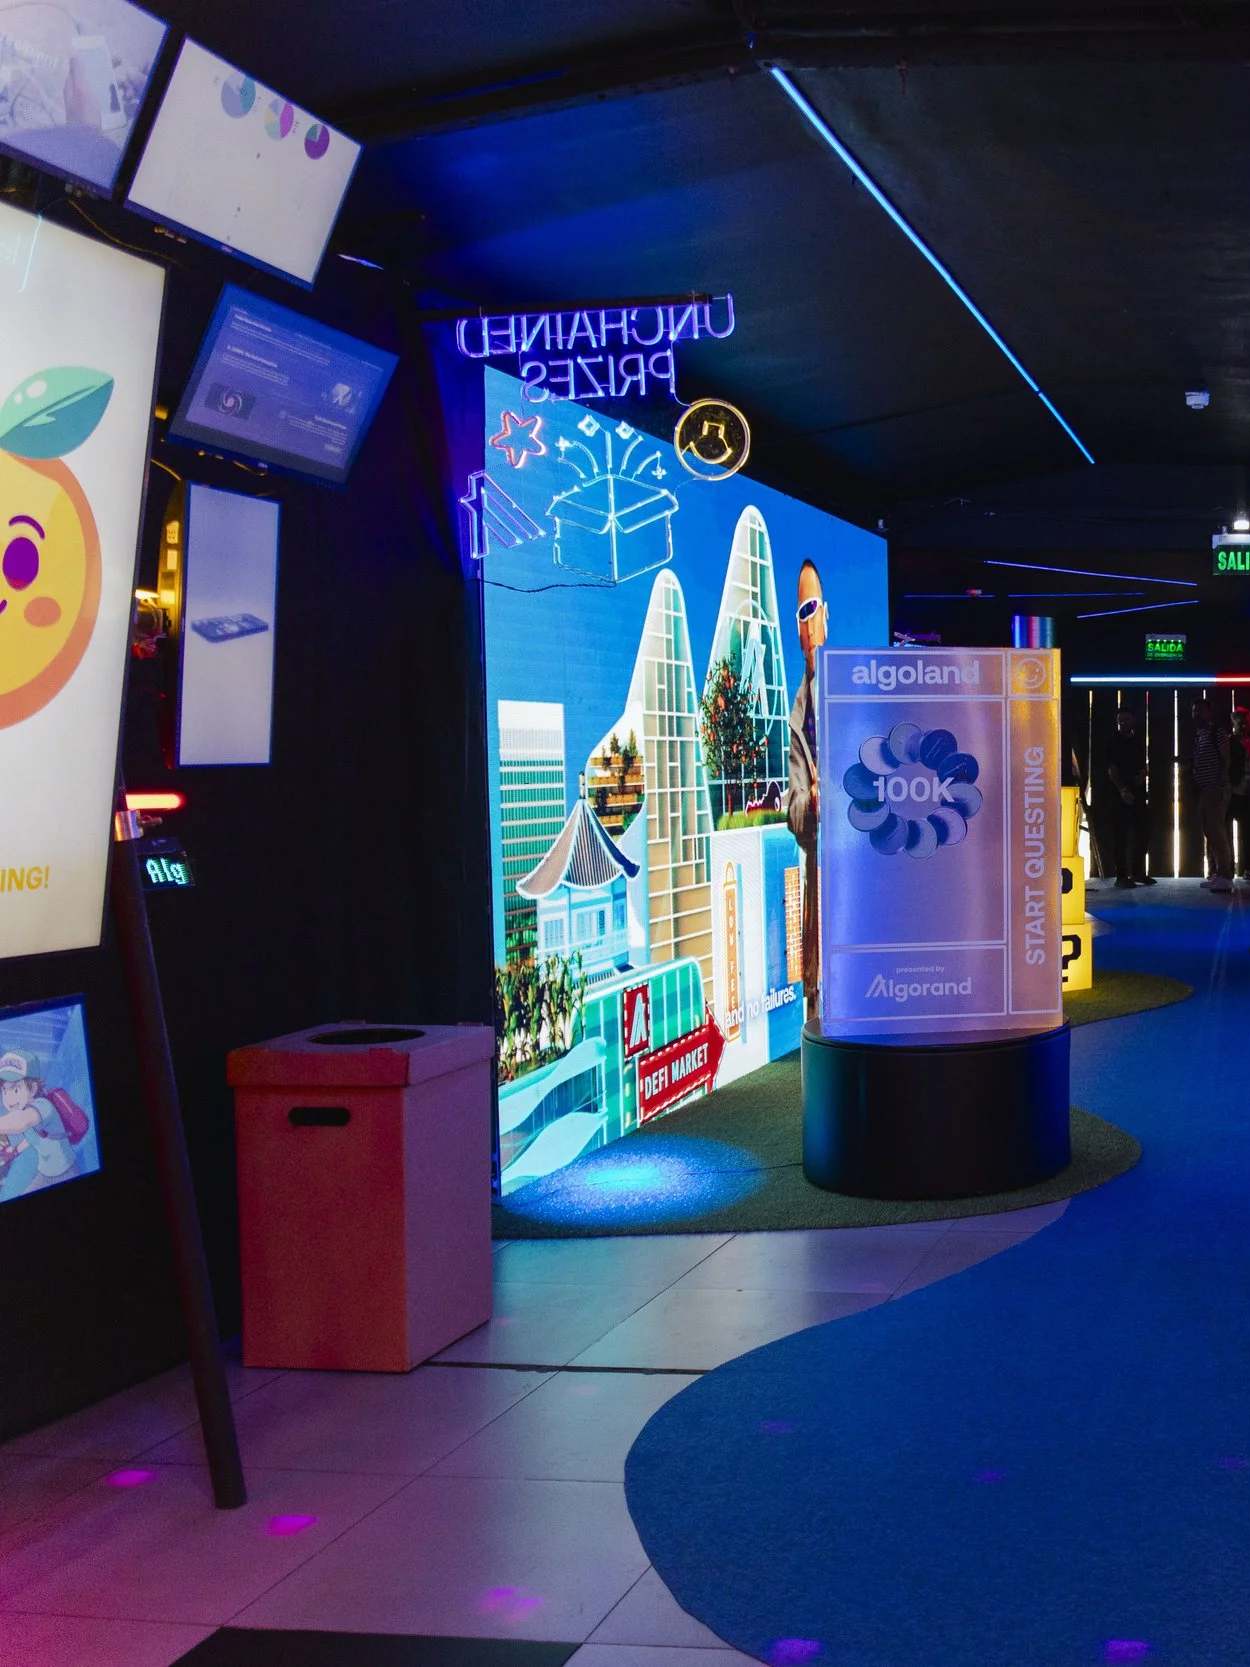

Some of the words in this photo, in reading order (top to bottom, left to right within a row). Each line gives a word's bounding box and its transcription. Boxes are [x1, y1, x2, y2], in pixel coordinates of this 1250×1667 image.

[1147, 643, 1183, 652] SALIDA
[852, 660, 980, 691] algoland
[873, 776, 955, 802] 100K
[1024, 747, 1046, 879] QUESTING
[146, 857, 190, 884] Alg
[1025, 885, 1046, 965] START
[896, 966, 934, 974] presented
[935, 965, 945, 973] by
[865, 974, 972, 1002] Algorand
[726, 1001, 744, 1030] and
[747, 1002, 760, 1018] no
[644, 1070, 668, 1100] DEFI
[671, 1043, 708, 1084] MARKET
